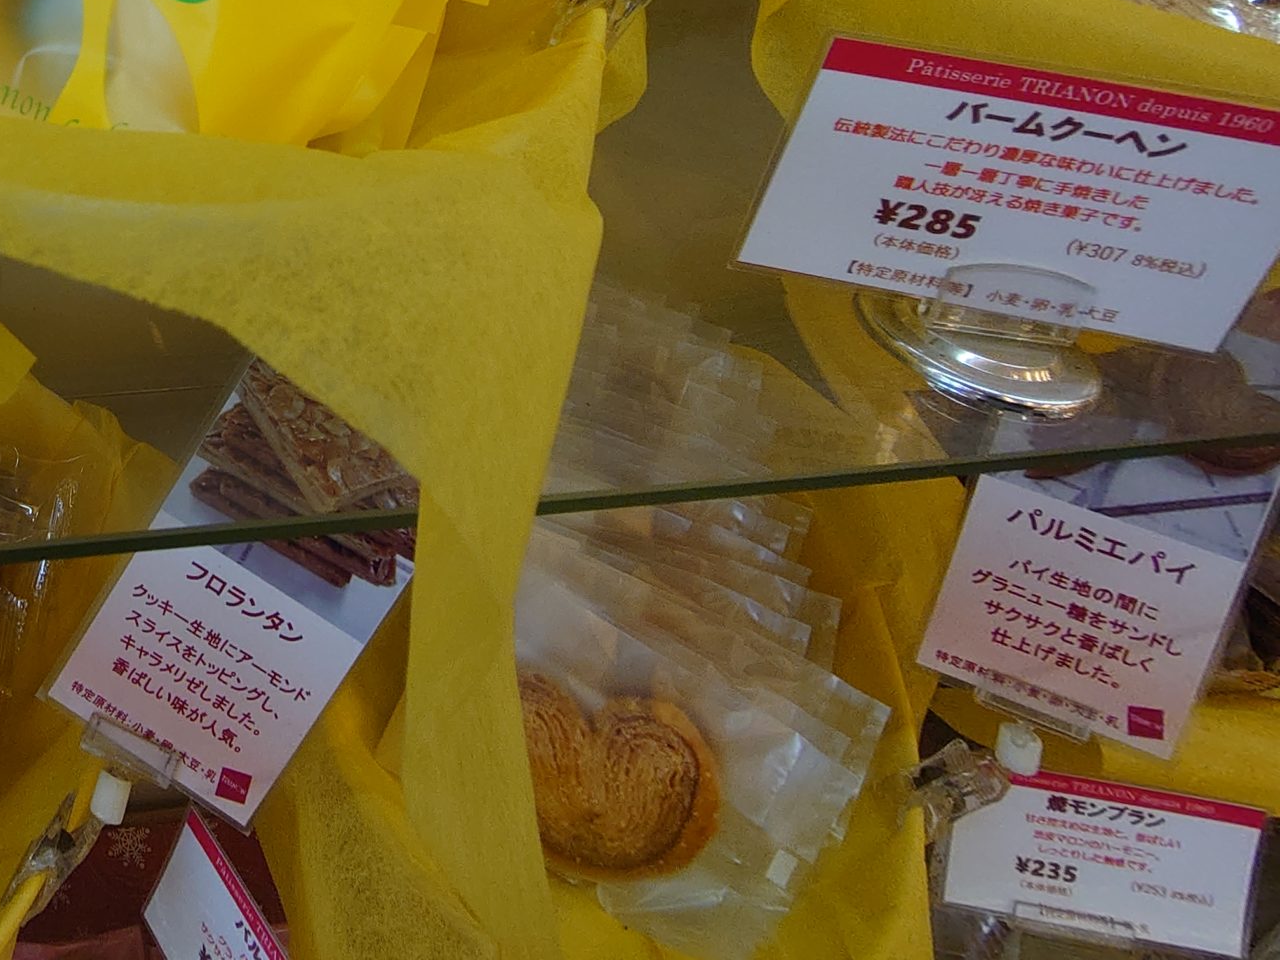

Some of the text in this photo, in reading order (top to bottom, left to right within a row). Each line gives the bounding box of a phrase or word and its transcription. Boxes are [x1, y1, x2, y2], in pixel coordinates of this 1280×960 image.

[906, 58, 1276, 134] Pâtisserie TRIANON depuis 1960
[945, 100, 1188, 159] バームクーヘン
[833, 117, 1260, 206] 伝統製法にこだわり濃厚な味わいに仕上げました。
[873, 198, 983, 240] ¥285
[894, 175, 1144, 232] 職人技が冴える焼き菓子です。
[1007, 507, 1196, 585] パルミエパイ
[186, 560, 304, 644] フロランタン
[971, 569, 1183, 658] グラニュー糖をサンドし
[1009, 559, 1160, 622] パイ生地の間に
[125, 610, 281, 721] スライスをトッピングし、
[132, 583, 311, 703] クッキー生地にアーモンド
[984, 599, 1151, 673] サクサクと香ばしく
[990, 627, 1121, 690] 仕上げました。
[112, 657, 242, 754] 香ばしい味が人気。
[119, 635, 261, 736] キャラメリゼしました。
[1015, 855, 1078, 883] ¥235
